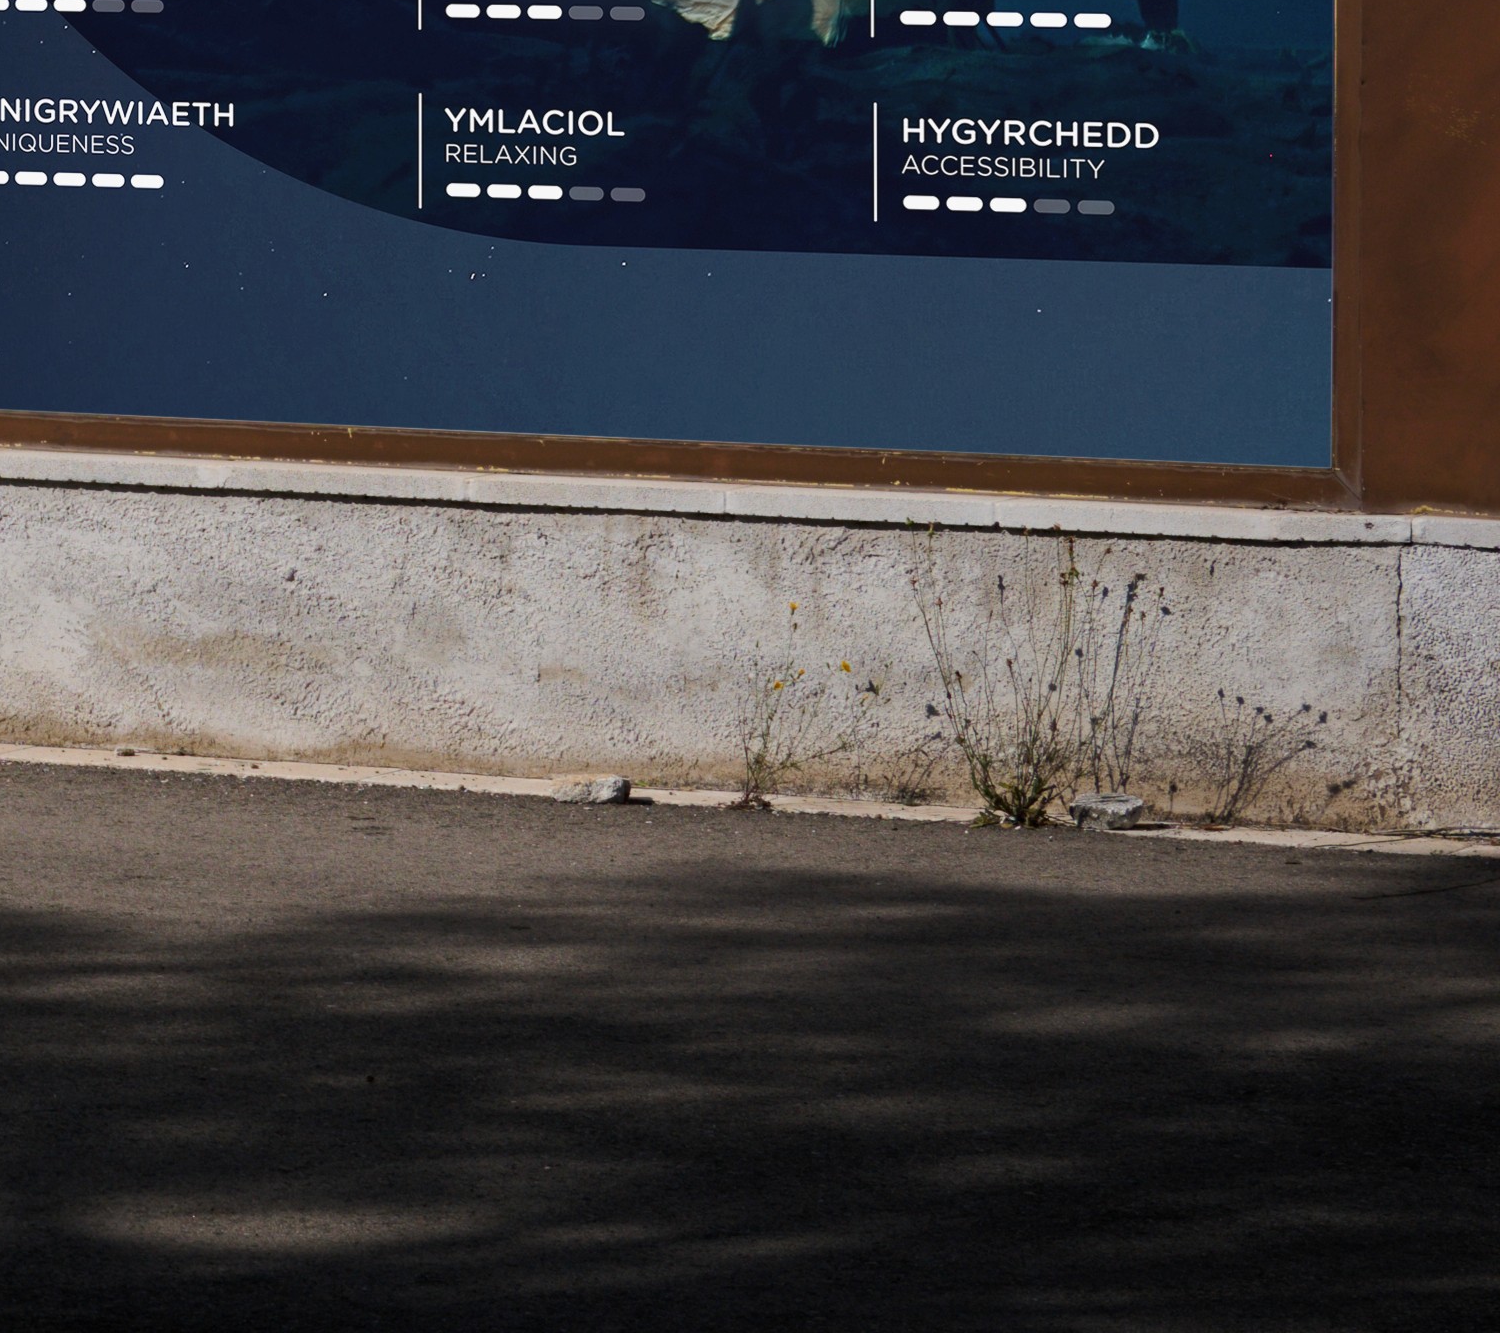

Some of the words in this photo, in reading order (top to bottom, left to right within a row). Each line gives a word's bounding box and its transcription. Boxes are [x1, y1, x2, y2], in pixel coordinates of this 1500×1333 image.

[444, 107, 626, 139] YMLACIOL
[901, 117, 1160, 151] HYGYRCHEDD
[444, 143, 578, 167] RELAXING
[901, 155, 1106, 181] ACCESSIBILITY
